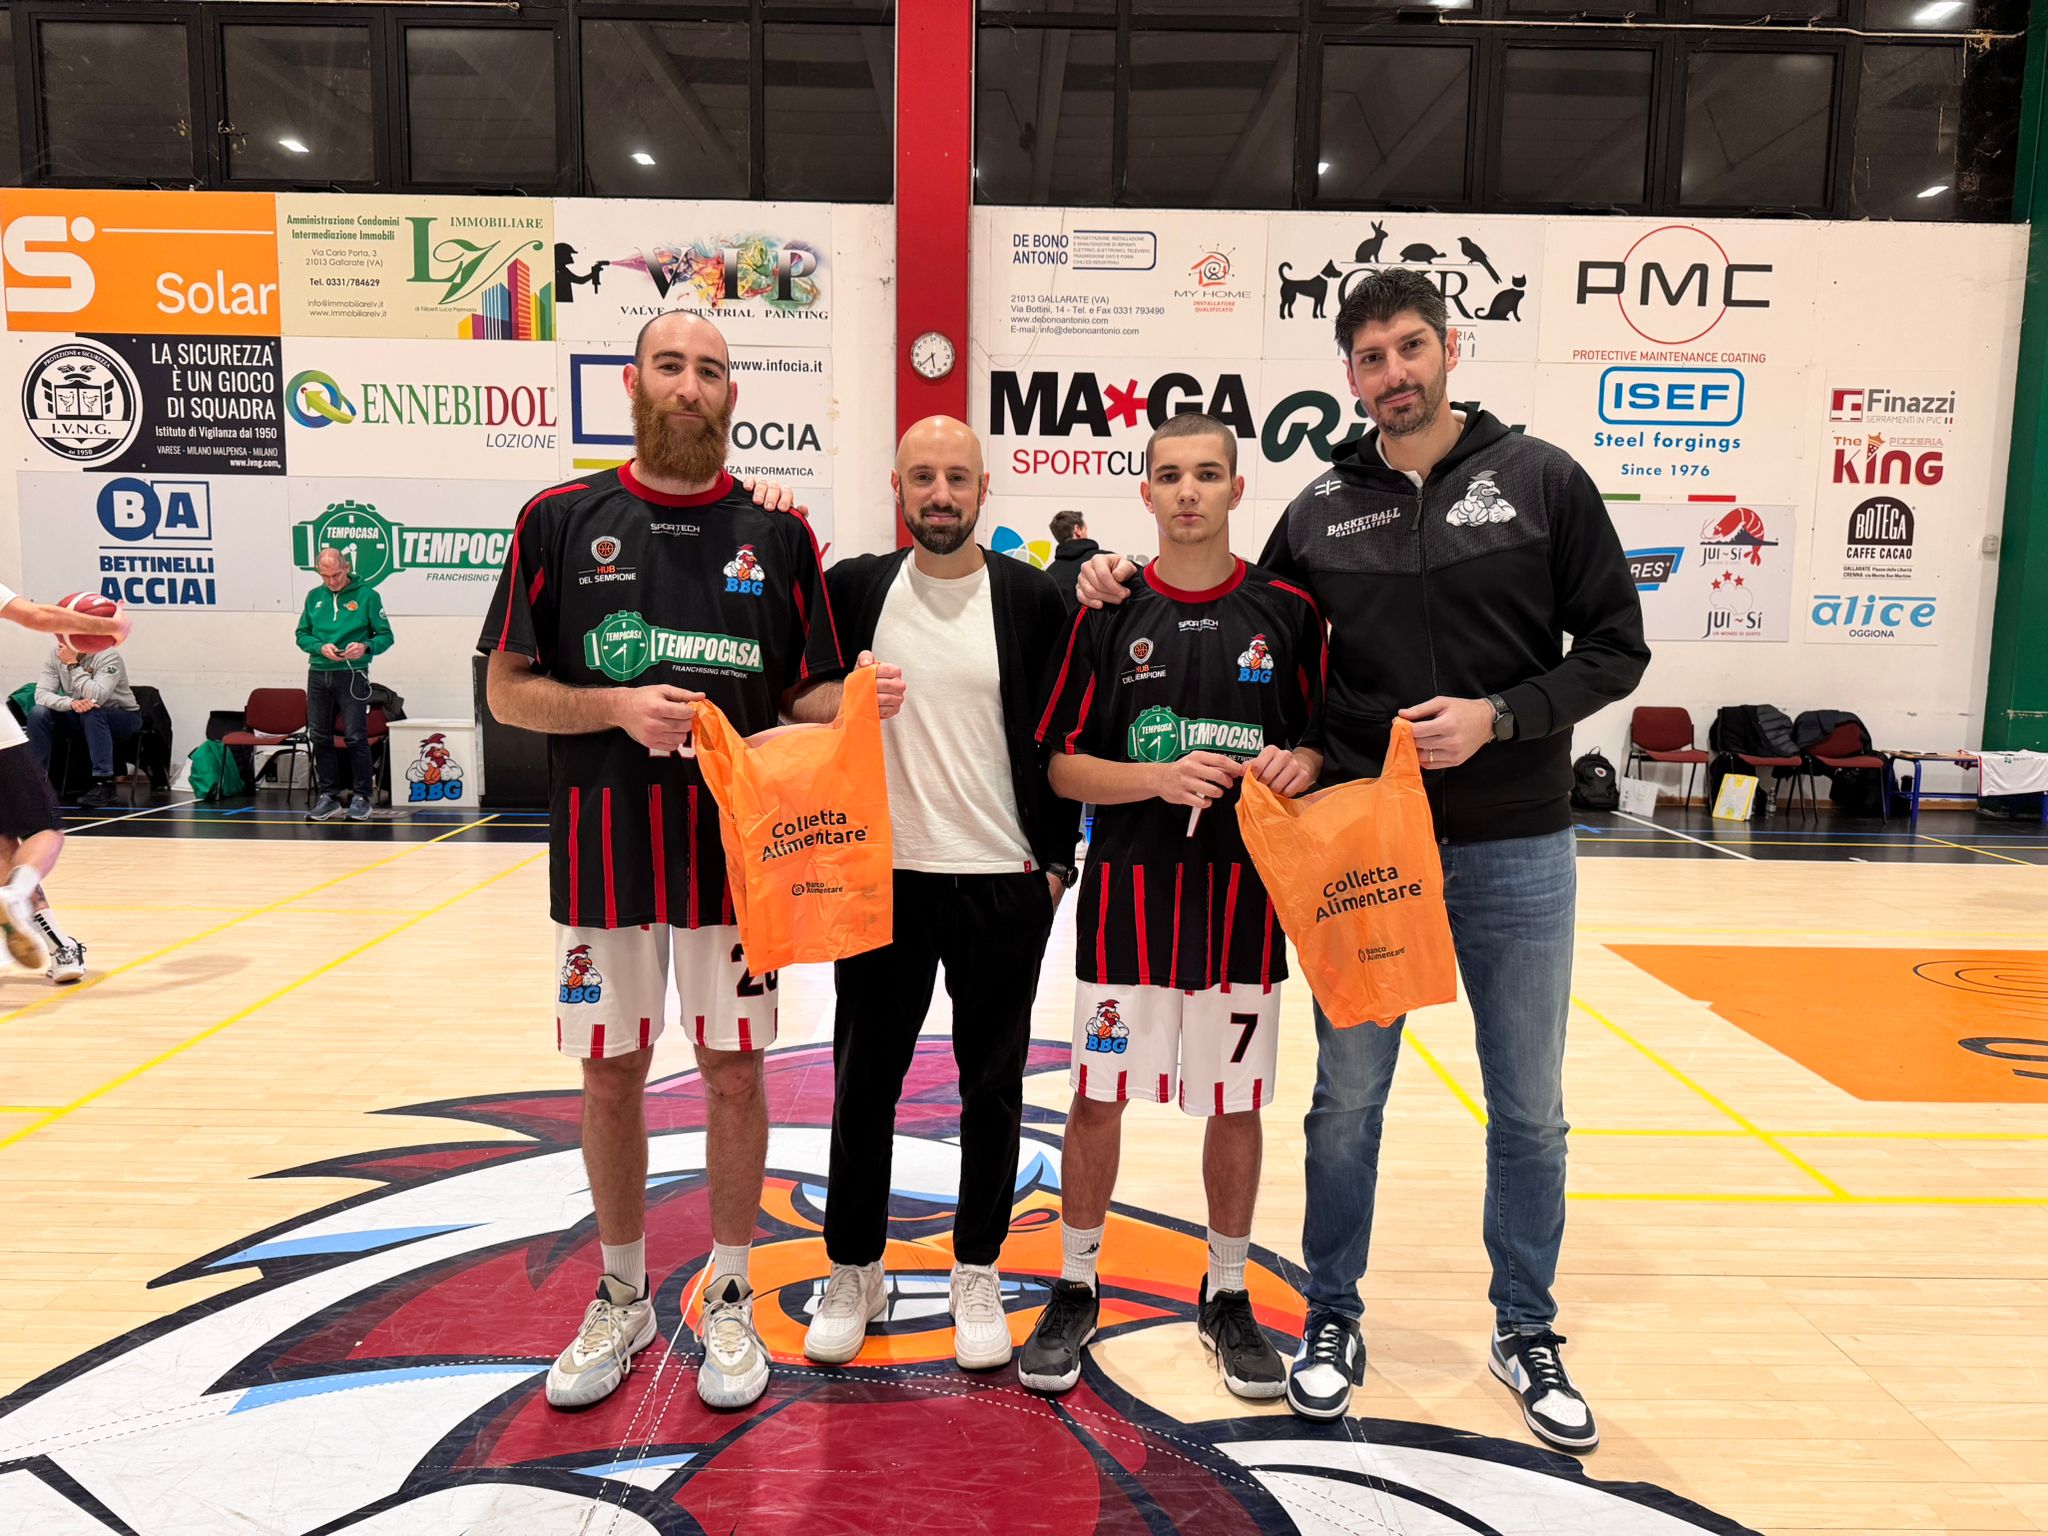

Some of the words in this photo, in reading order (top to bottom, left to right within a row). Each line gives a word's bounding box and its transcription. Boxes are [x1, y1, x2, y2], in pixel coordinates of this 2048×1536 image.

[287, 214, 354, 225] Amministrazione
[357, 215, 400, 226] Condomini
[450, 216, 543, 229] IMMOBILIARE
[292, 229, 357, 240] Intermediazione
[359, 230, 395, 240] Immobili
[1013, 234, 1030, 248] DE
[1033, 234, 1069, 249] BONO
[305, 258, 327, 266] 21013
[329, 258, 365, 266] Gallarate
[366, 259, 383, 268] (VA)
[1012, 251, 1068, 265] ANTONIO
[634, 246, 817, 300] VIP
[309, 278, 324, 286] Tel.
[326, 278, 380, 287] 0331/784629
[1576, 260, 1773, 308] PMC
[156, 269, 276, 315] Solar
[1203, 290, 1252, 298] HOME
[1010, 294, 1036, 303] 21013
[1037, 295, 1089, 304] GALLARATE
[1091, 295, 1110, 305] (VA)
[620, 306, 665, 316] VALVE
[765, 309, 829, 320] PAINTING
[1010, 305, 1024, 313] Via
[1026, 305, 1053, 314] Bottini,
[1072, 306, 1086, 314] Tel.
[1096, 306, 1111, 314] Fax
[1113, 306, 1132, 315] 0331
[1135, 306, 1165, 315] 793490
[1010, 315, 1108, 324] www.debonoantonio.com
[1039, 326, 1139, 335] info@debonoantonio.com
[152, 343, 172, 365] LA
[178, 343, 274, 367] SICUREZZA
[1572, 349, 1637, 361] PROTECTIVE
[1640, 350, 1718, 362] MAINTENANCE
[1720, 352, 1766, 363] COATING
[729, 359, 823, 373] www.infocia.it
[172, 367, 182, 392] È
[188, 370, 214, 392] UN
[218, 372, 274, 393] GIOCO
[1613, 382, 1730, 410] ISEF
[1866, 388, 1955, 414] Finazzi
[167, 397, 184, 418] DI
[191, 397, 276, 421] SQUADRA
[361, 383, 557, 428] ENNEBIDOL
[1866, 415, 1915, 424] SERRAMENTI
[1926, 416, 1942, 424] PVC
[52, 423, 111, 435] I.V.N.G.
[155, 426, 186, 437] Istituto
[189, 426, 197, 437] di
[199, 426, 237, 439] Vigilanza
[239, 427, 253, 438] dal
[254, 428, 277, 439] 1950
[731, 421, 821, 451] OCIA
[486, 433, 557, 449] LOZIONE
[1594, 431, 1644, 448] Steel
[1653, 431, 1741, 453] forgings
[1833, 436, 1862, 446] The
[1889, 437, 1944, 446] PIZZERIA
[157, 445, 182, 455] VARESE
[213, 446, 247, 456] MALPENSA
[1012, 448, 1147, 476] SPORTCU
[744, 466, 814, 476] INFORMATICA
[1620, 463, 1662, 476] Since
[1670, 464, 1710, 477] 1976
[1326, 507, 1400, 537] BASKETBALL
[1855, 504, 1907, 540] BOTEGA
[326, 526, 379, 540] TEMPOCASA
[402, 532, 514, 565] TEMPOC
[1846, 547, 1876, 559] CAFFE
[1880, 547, 1912, 559] CACAO
[99, 555, 214, 574] BETTINELLI
[597, 565, 616, 574] HUB
[1630, 561, 1664, 579] RES
[426, 572, 489, 582] FRANCHISING
[578, 576, 593, 585] DEL
[594, 572, 637, 583] SEMPIONE
[100, 576, 216, 605] ACCIAI
[724, 577, 764, 597] BBG
[1811, 594, 1937, 628] alice
[605, 630, 642, 642] TEMPOCASA
[1849, 629, 1895, 638] OGGIONA
[672, 664, 719, 675] FRANCHISING
[1237, 667, 1272, 683] BBG
[408, 779, 463, 802] BBG
[771, 809, 847, 839] Colletta
[762, 828, 867, 862] Alimentare
[1323, 866, 1399, 899] Colletta
[1316, 882, 1422, 923] Alimentare
[1365, 946, 1387, 955] Banco
[1367, 948, 1404, 961] Alimentare
[559, 984, 602, 1003] BBG
[1085, 1034, 1128, 1054] BBG
[1230, 1012, 1258, 1063] 7
